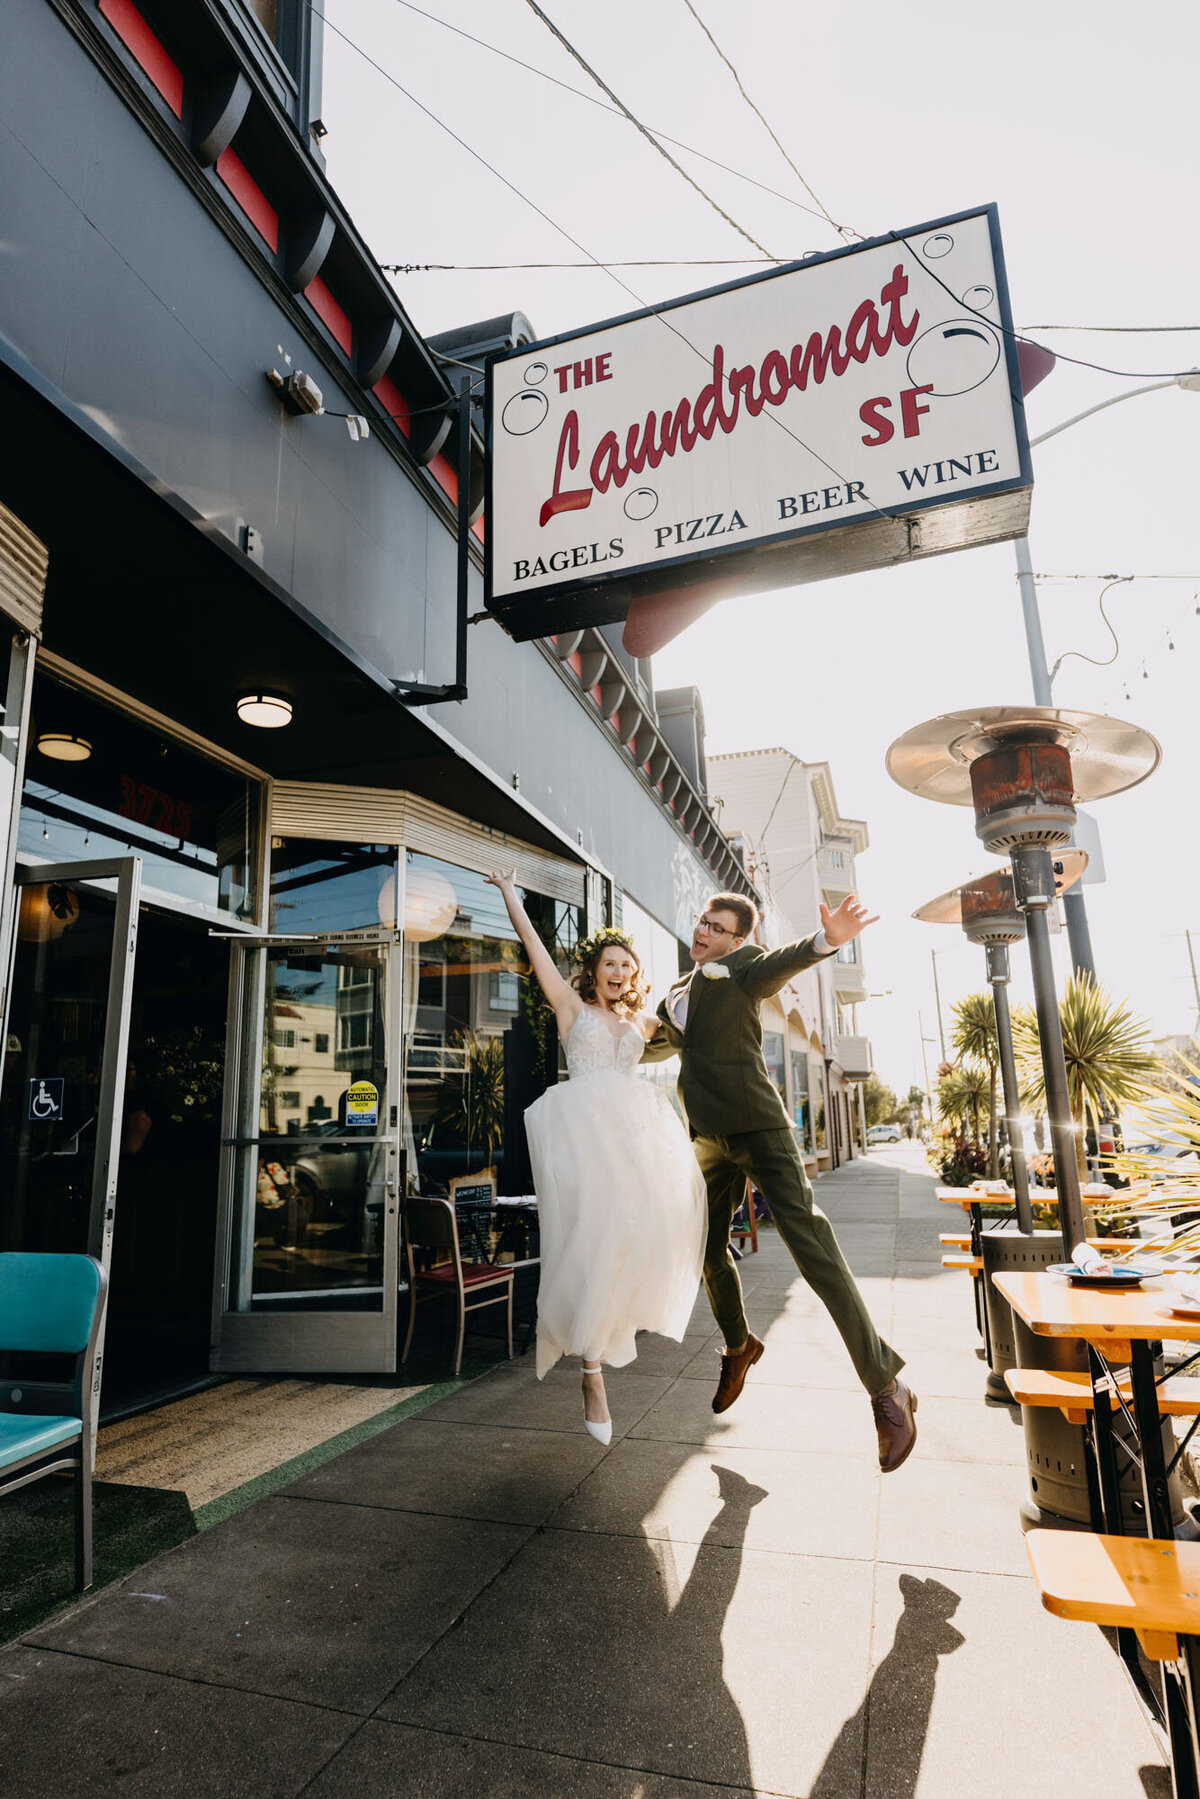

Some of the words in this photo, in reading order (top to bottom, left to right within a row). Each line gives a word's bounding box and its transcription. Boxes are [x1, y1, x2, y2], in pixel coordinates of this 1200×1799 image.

[539, 263, 920, 528] Laundromat
[553, 351, 613, 394] THE
[859, 383, 934, 447] SF
[512, 537, 625, 582] BAGELS
[654, 509, 748, 550] PIZZA
[777, 480, 871, 520] BEER
[897, 449, 1000, 491] WINE
[118, 773, 192, 840] 3725
